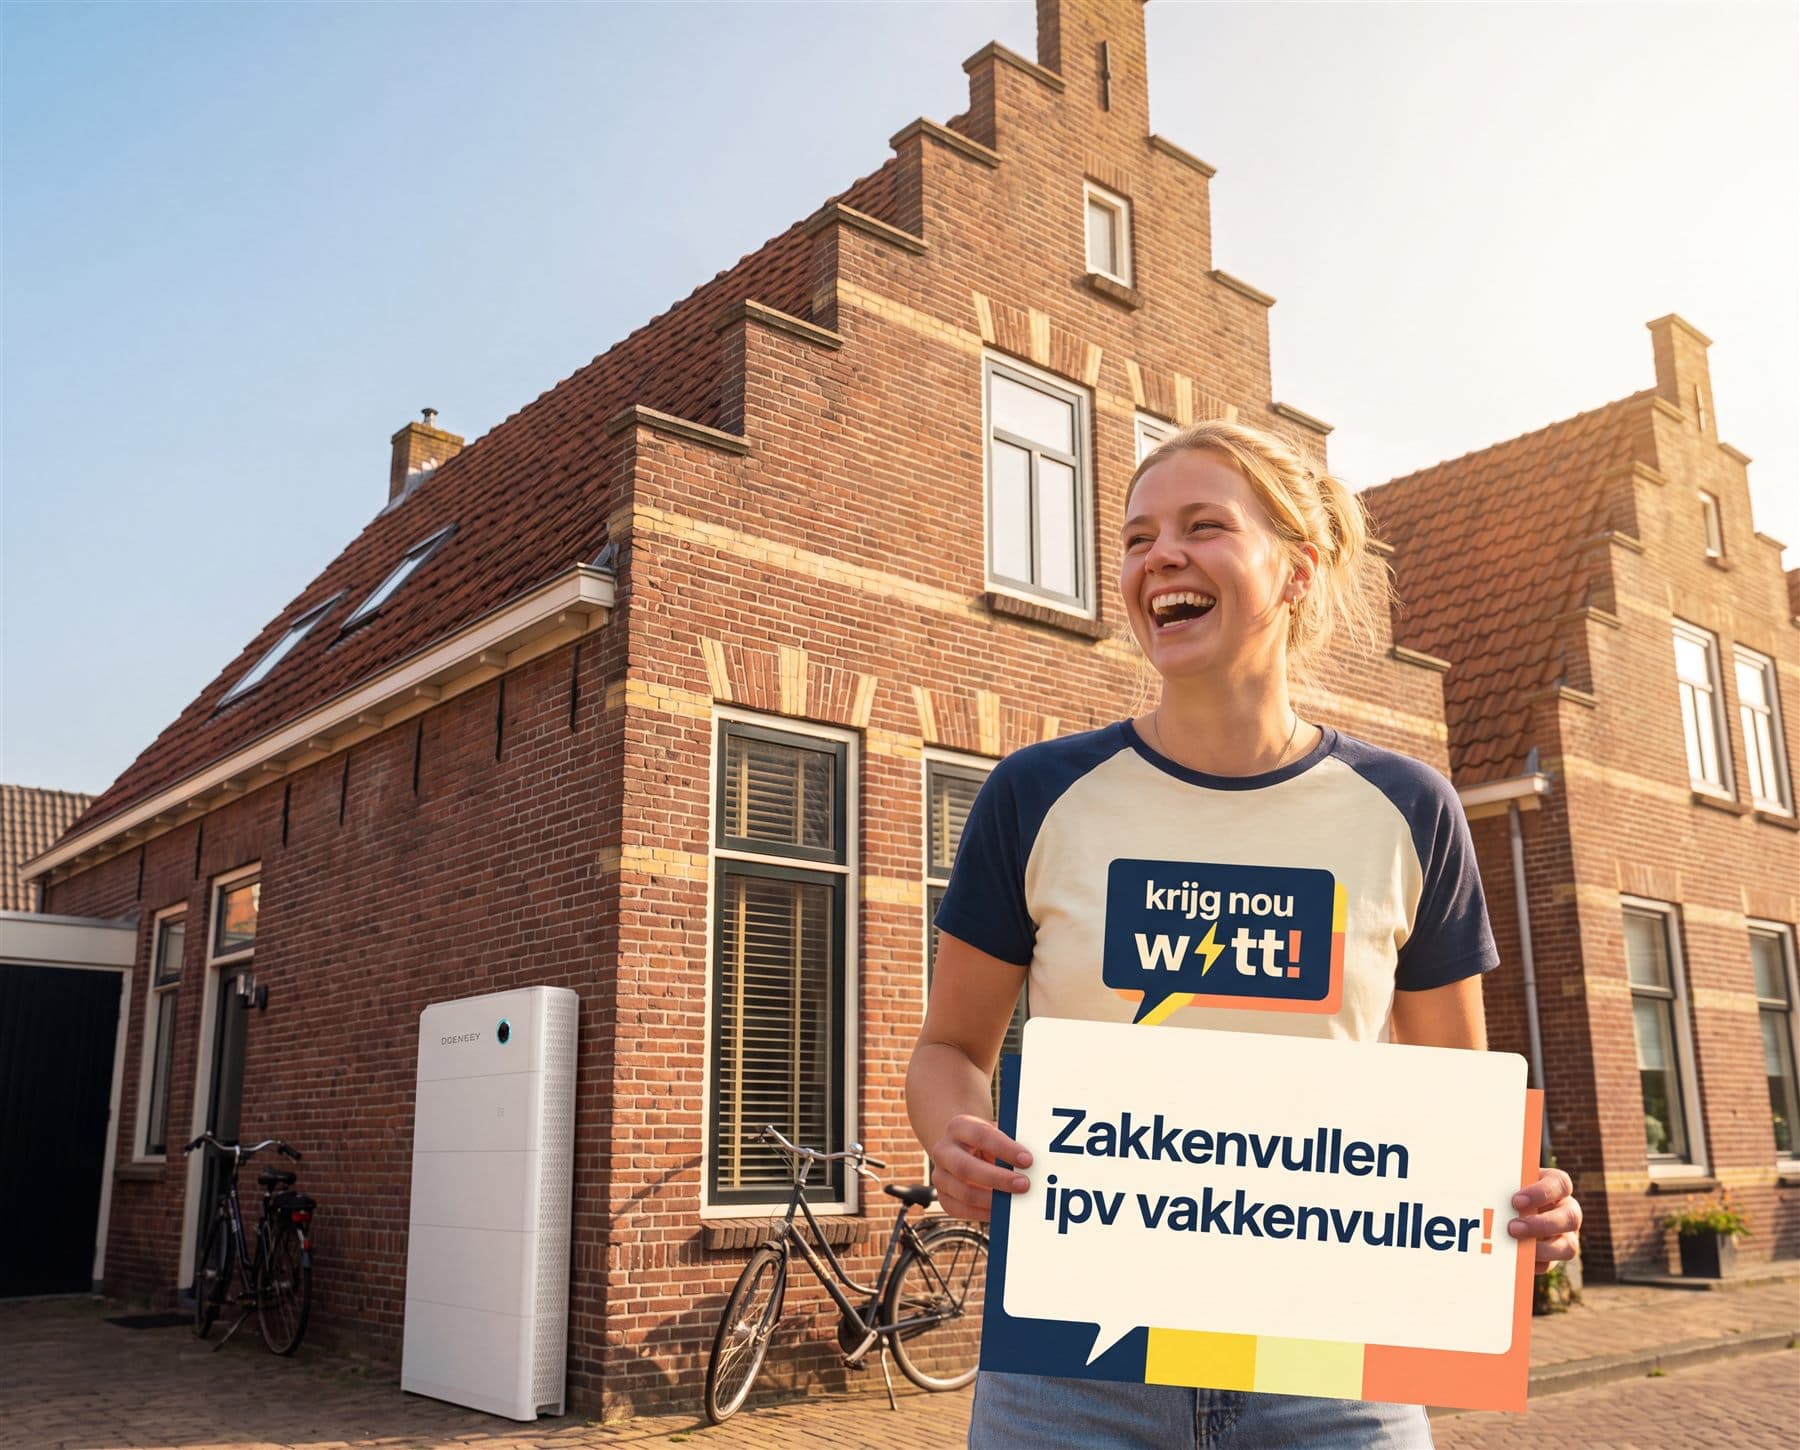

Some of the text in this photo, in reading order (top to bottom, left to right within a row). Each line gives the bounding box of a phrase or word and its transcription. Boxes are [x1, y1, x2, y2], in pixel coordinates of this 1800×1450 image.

[1145, 879, 1294, 921] krijg nou
[1048, 1107, 1410, 1179] Zakkenvullen
[1044, 1174, 1495, 1255] ipv vakkenvuller!
